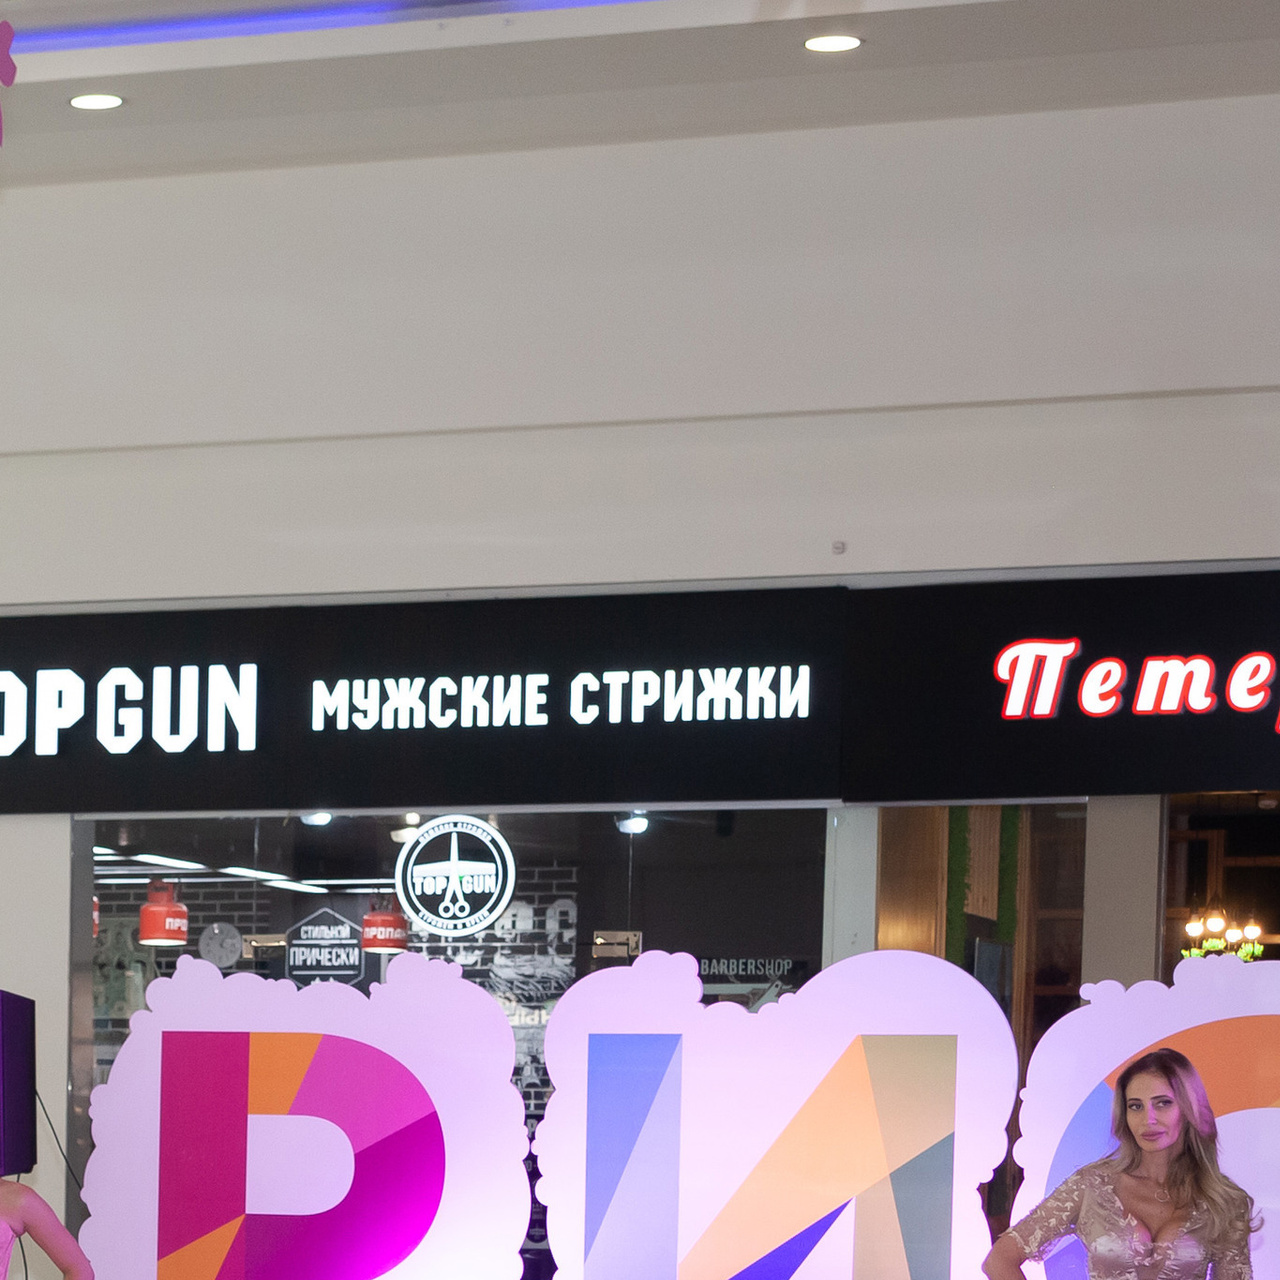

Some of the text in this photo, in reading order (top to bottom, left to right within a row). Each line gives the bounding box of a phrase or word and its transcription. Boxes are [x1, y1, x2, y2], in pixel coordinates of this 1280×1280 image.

[993, 637, 1280, 734] Пете
[313, 666, 809, 730] МУЖСКИЕ СТРИЖКИ
[412, 874, 496, 895] TOP GUN
[301, 923, 351, 939] СТИЛЬНОЙ
[289, 946, 360, 966] ПРИЧЕСКИ
[700, 958, 793, 976] BARBERSHOP
